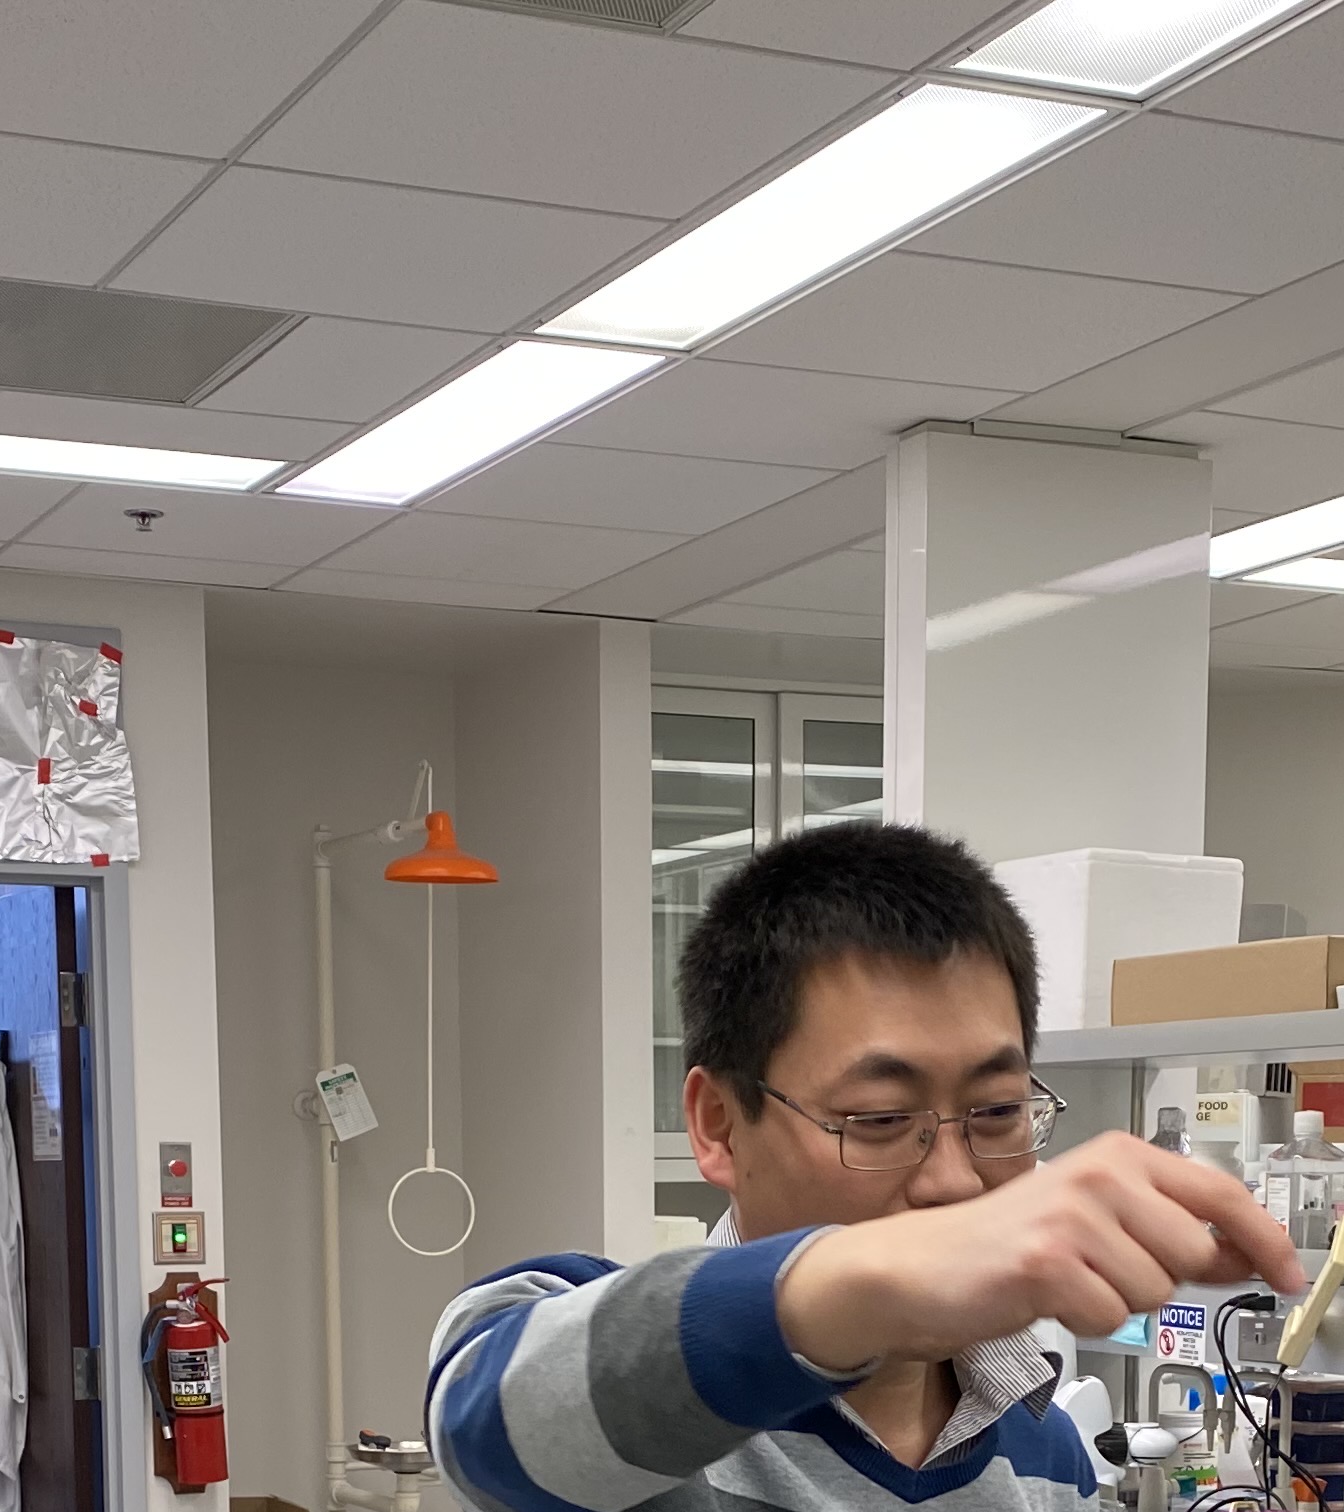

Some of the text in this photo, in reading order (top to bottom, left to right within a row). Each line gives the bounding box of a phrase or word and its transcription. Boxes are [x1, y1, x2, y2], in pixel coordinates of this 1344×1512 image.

[1198, 1102, 1229, 1111] FOOD
[1196, 1112, 1211, 1121] GE
[1162, 1308, 1203, 1326] NOTICE
